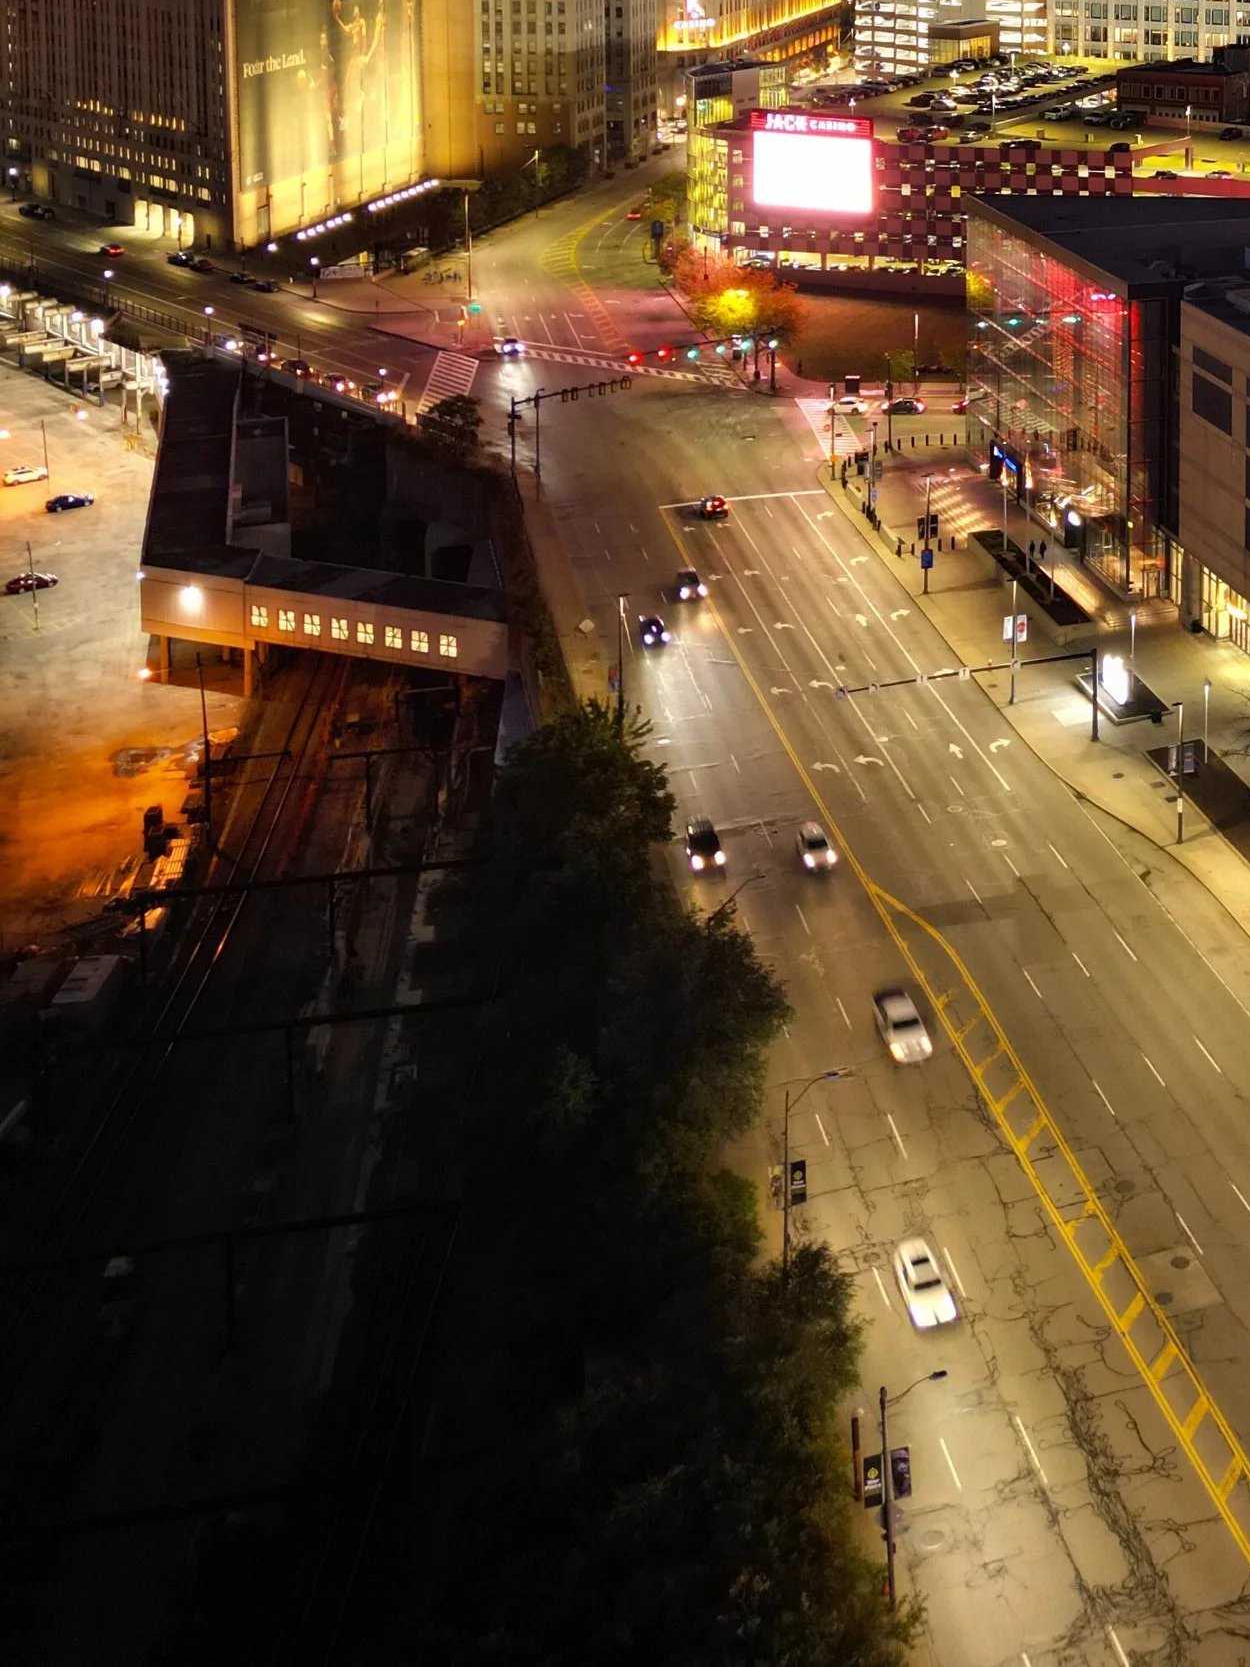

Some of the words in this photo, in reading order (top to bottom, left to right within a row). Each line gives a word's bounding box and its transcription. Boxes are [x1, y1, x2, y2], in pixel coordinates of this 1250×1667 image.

[266, 55, 281, 72] the
[765, 113, 807, 132] JACK
[809, 119, 857, 132] CASINO
